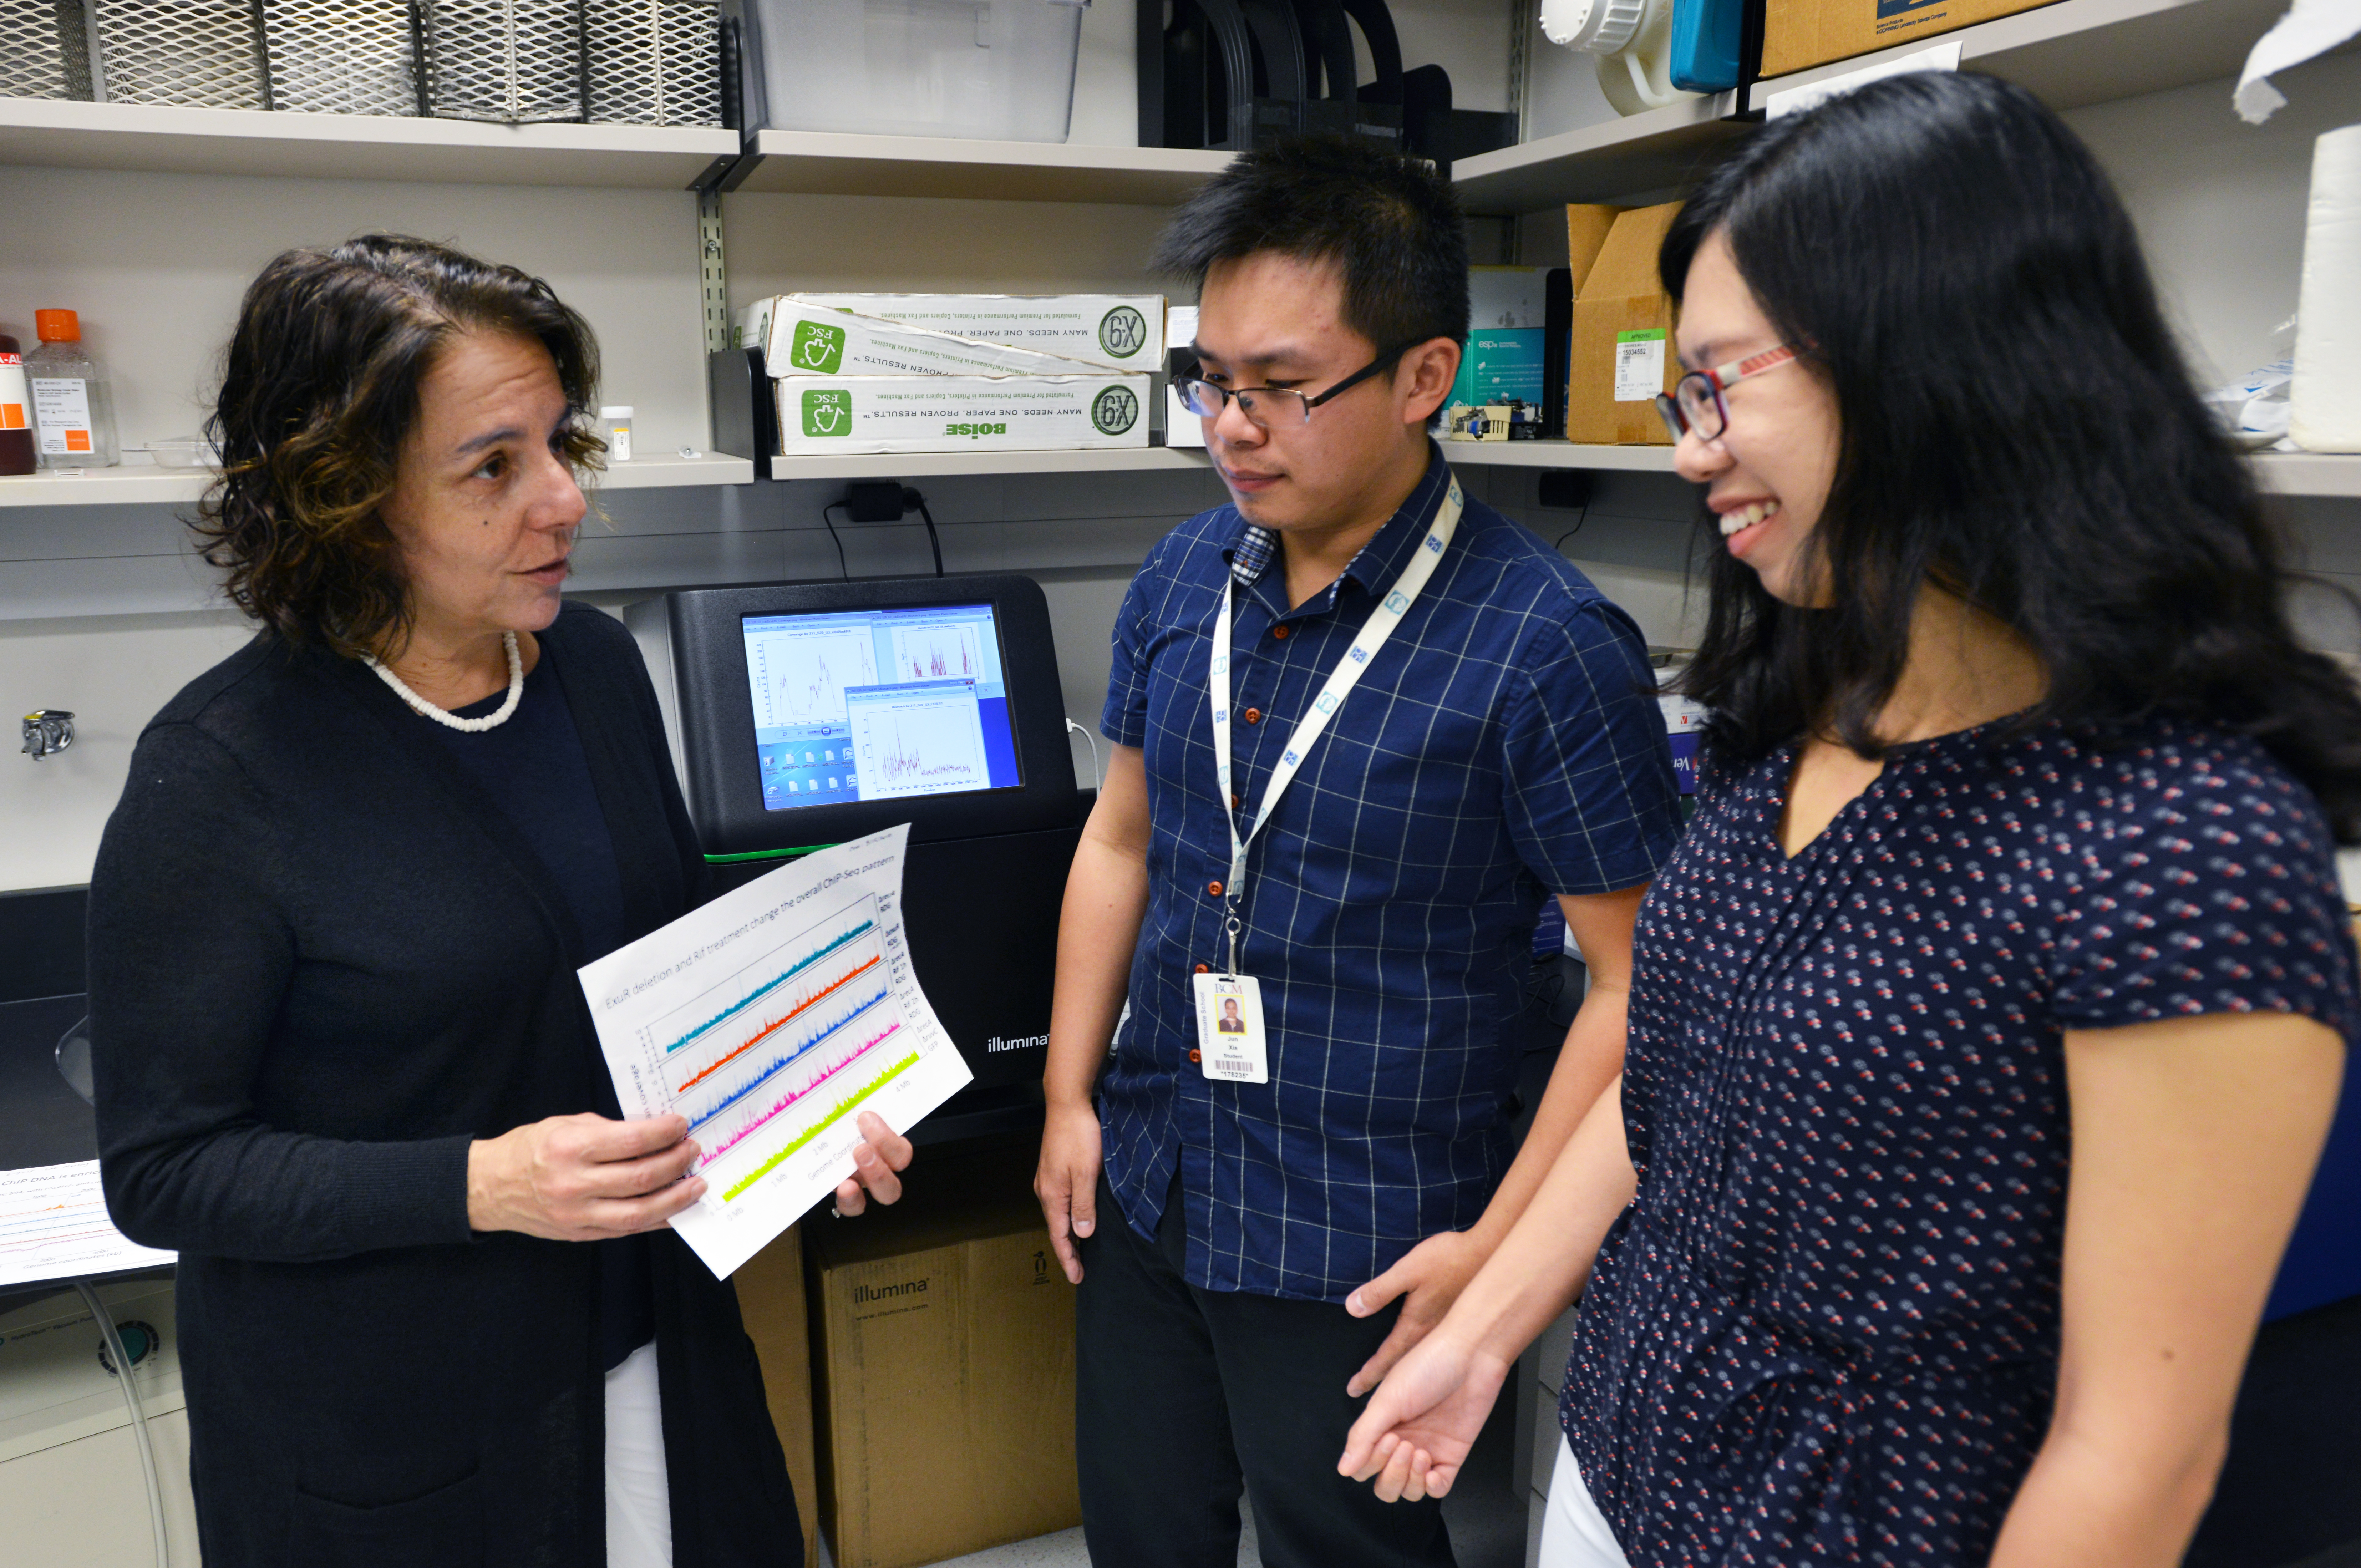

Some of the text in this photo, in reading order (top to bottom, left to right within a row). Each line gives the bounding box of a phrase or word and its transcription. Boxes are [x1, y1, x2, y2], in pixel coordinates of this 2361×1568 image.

[807, 326, 835, 339] FSC
[870, 339, 896, 350] Machines.
[919, 349, 939, 359] Copiers
[941, 353, 964, 364] Printers,
[971, 360, 1004, 372] Performance
[814, 394, 839, 403] FSC
[606, 989, 630, 1009] ExuR
[633, 969, 672, 995] deletion
[675, 955, 692, 973] and
[693, 946, 706, 962] Rif
[707, 924, 749, 954] treatment
[750, 908, 779, 929] change
[781, 900, 794, 912] the
[796, 882, 822, 904] overall
[862, 856, 894, 873] pattern
[1215, 984, 1243, 994] BCM
[909, 1008, 921, 1019] RDG
[928, 1041, 938, 1052] GFP
[988, 1035, 1048, 1052] illumina
[900, 1079, 911, 1089] Mb
[817, 1141, 828, 1152] Mb
[808, 1135, 865, 1181] Genome Coordinate
[775, 1174, 787, 1183] Mb
[732, 1208, 743, 1218] Mb
[59, 1255, 104, 1264] coordinates
[854, 1280, 928, 1303] illumina
[856, 1304, 928, 1321] www.illumina.com
